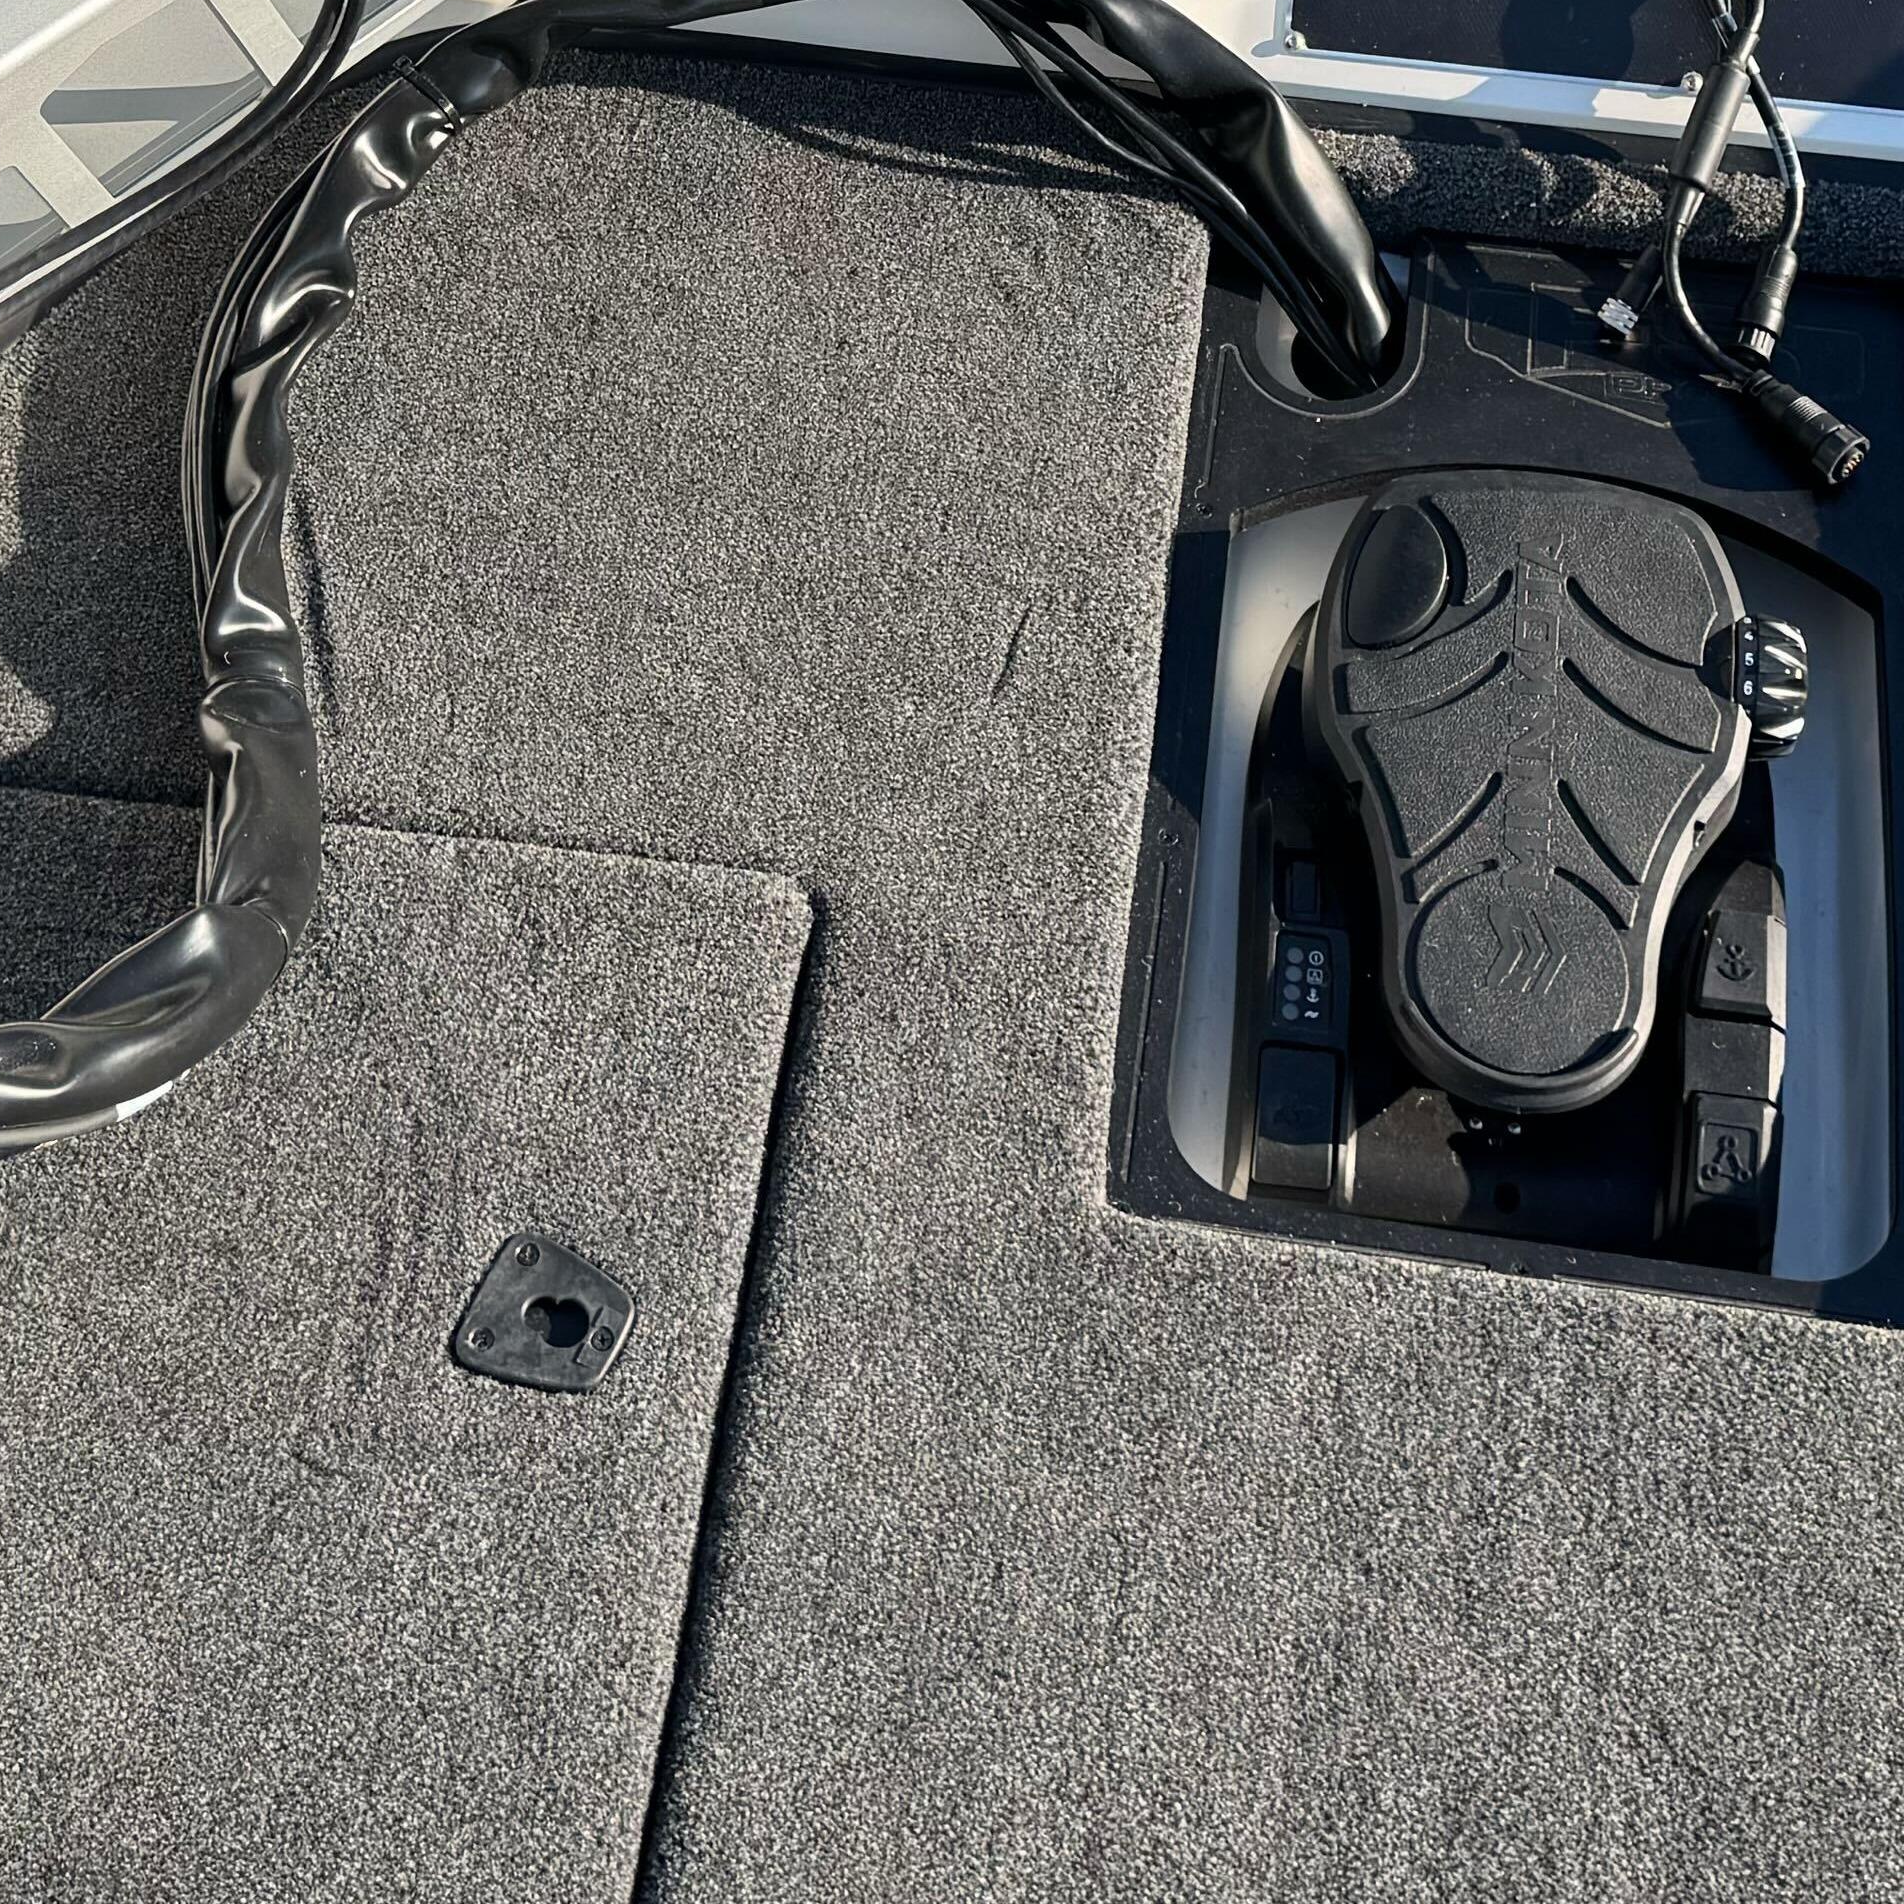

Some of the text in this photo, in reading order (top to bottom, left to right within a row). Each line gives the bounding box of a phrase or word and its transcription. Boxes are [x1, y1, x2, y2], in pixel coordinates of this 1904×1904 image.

[1744, 652, 1754, 666] 5
[1743, 680, 1753, 696] 6
[1501, 532, 1564, 894] MINN KOTA
